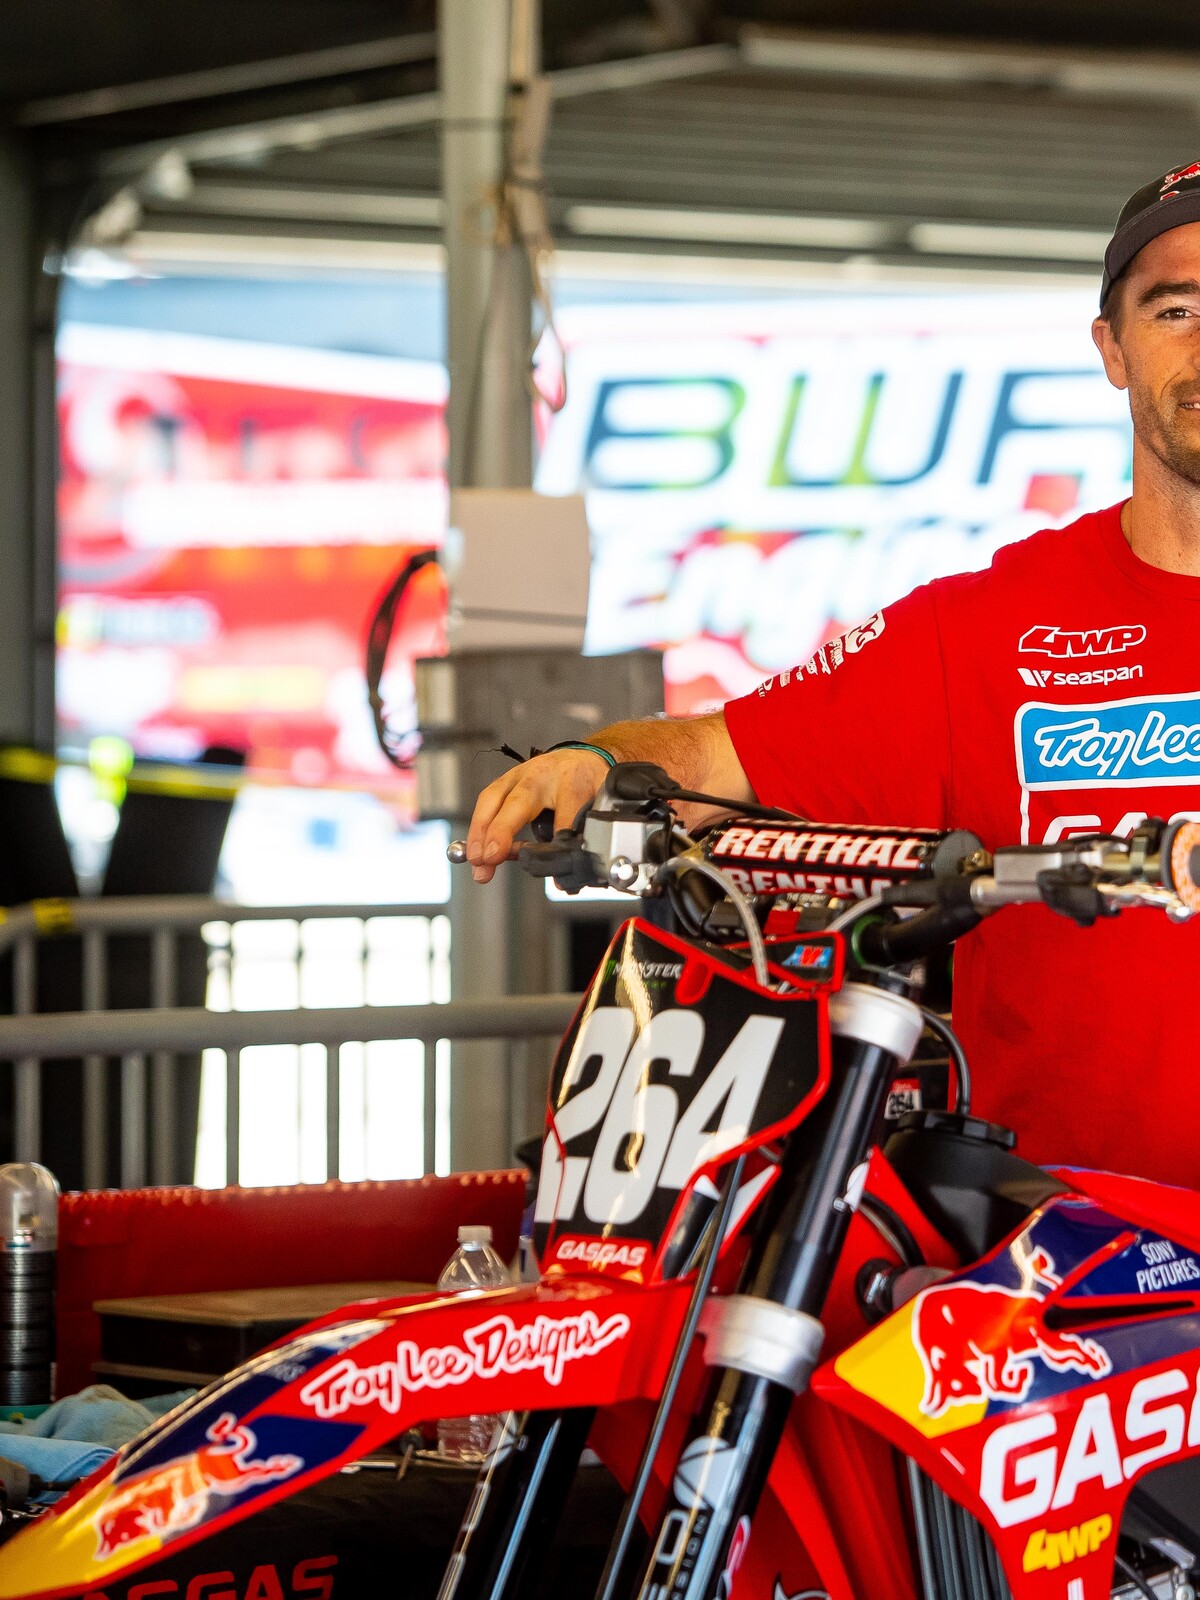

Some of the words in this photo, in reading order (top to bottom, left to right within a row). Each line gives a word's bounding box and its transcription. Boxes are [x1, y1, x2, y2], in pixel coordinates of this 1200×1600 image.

[1018, 624, 1146, 658] 4WP
[1053, 665, 1143, 686] seaspan
[1035, 718, 1134, 776] Troy
[713, 828, 920, 869] RENTHAL
[724, 868, 908, 899] RENTHA
[612, 961, 684, 979] MNSTER
[534, 1005, 786, 1225] 264
[556, 1240, 647, 1267] GASGAS
[1141, 1240, 1177, 1266] SONY
[300, 1359, 402, 1418] Troy
[397, 1340, 475, 1392] Lee
[464, 1310, 631, 1386] Designs
[1022, 1513, 1113, 1574] 4WP
